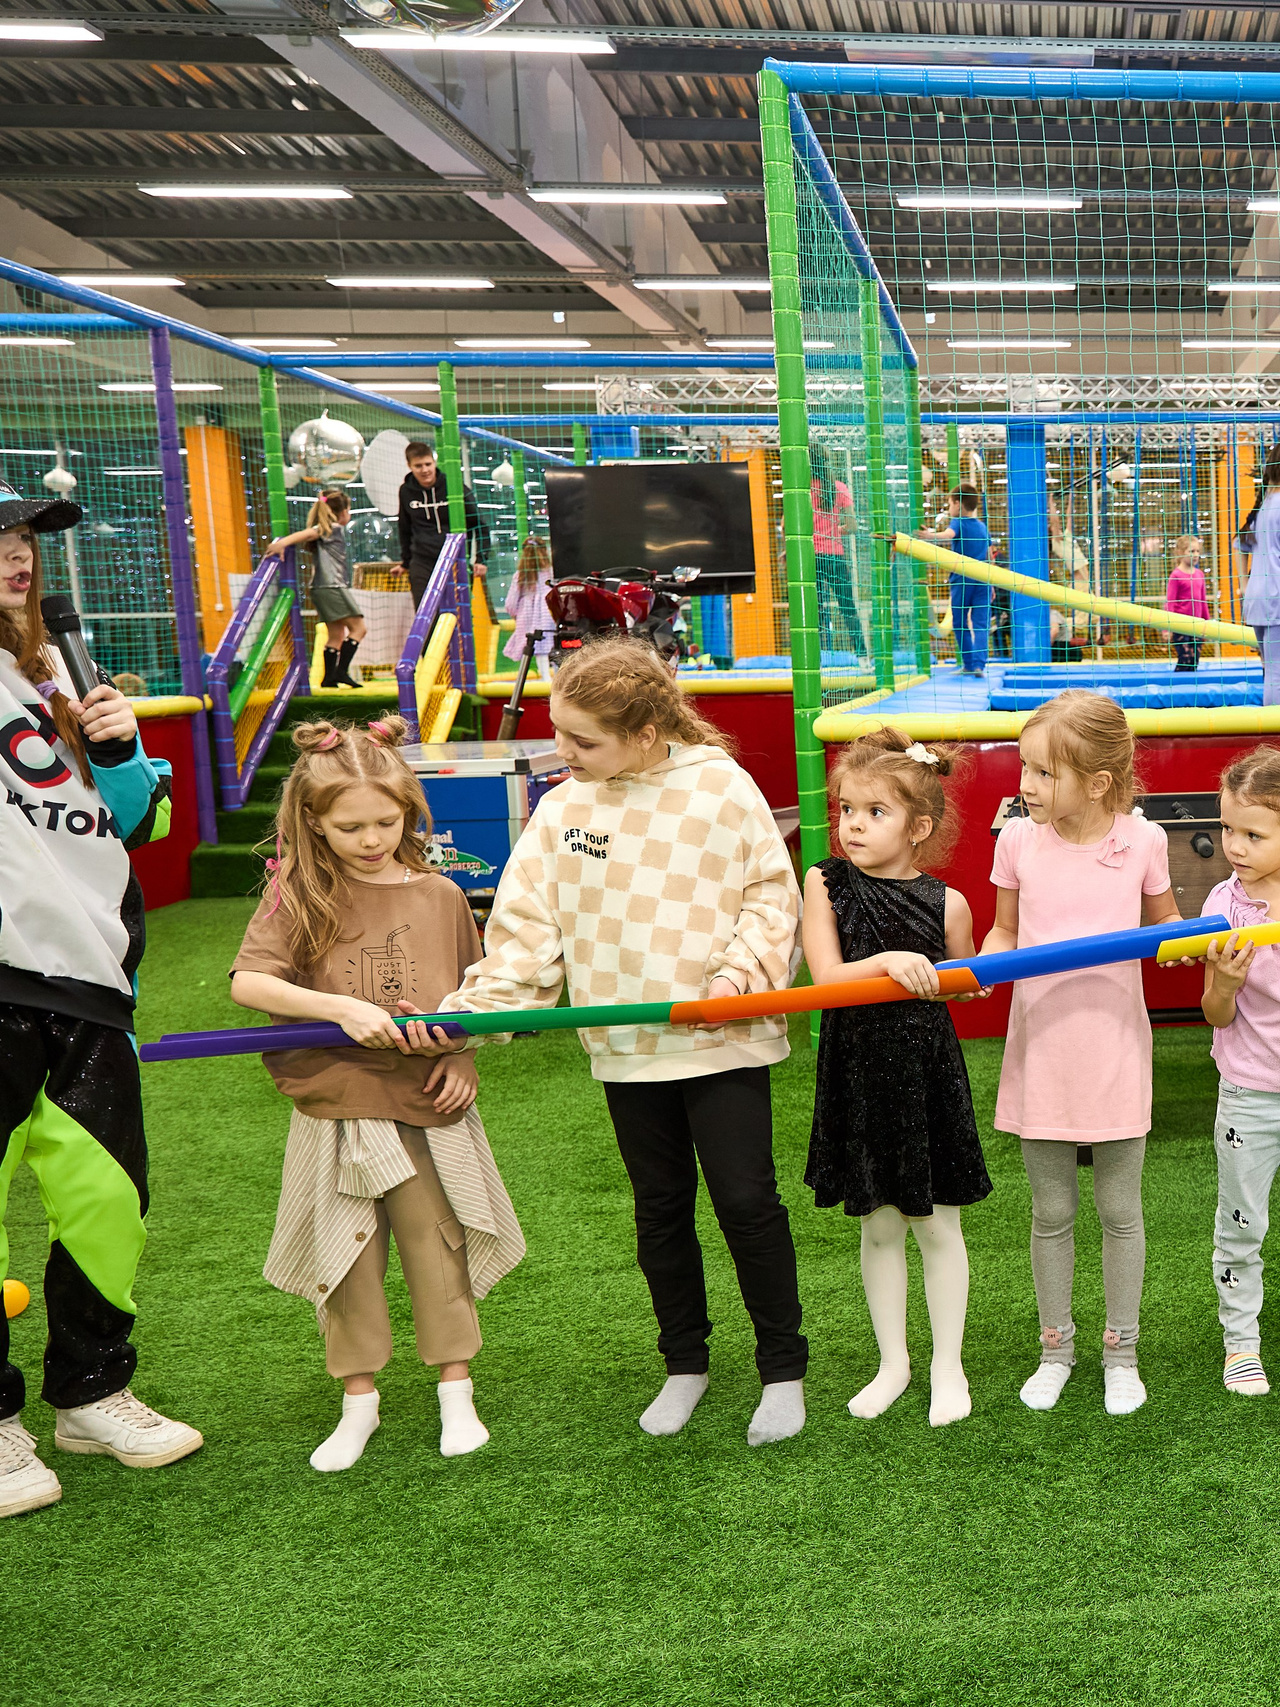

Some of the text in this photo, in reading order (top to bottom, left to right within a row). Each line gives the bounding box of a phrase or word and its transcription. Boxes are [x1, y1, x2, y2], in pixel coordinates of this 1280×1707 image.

[564, 828, 609, 846] GET YOUR
[571, 842, 607, 860] DREAMS
